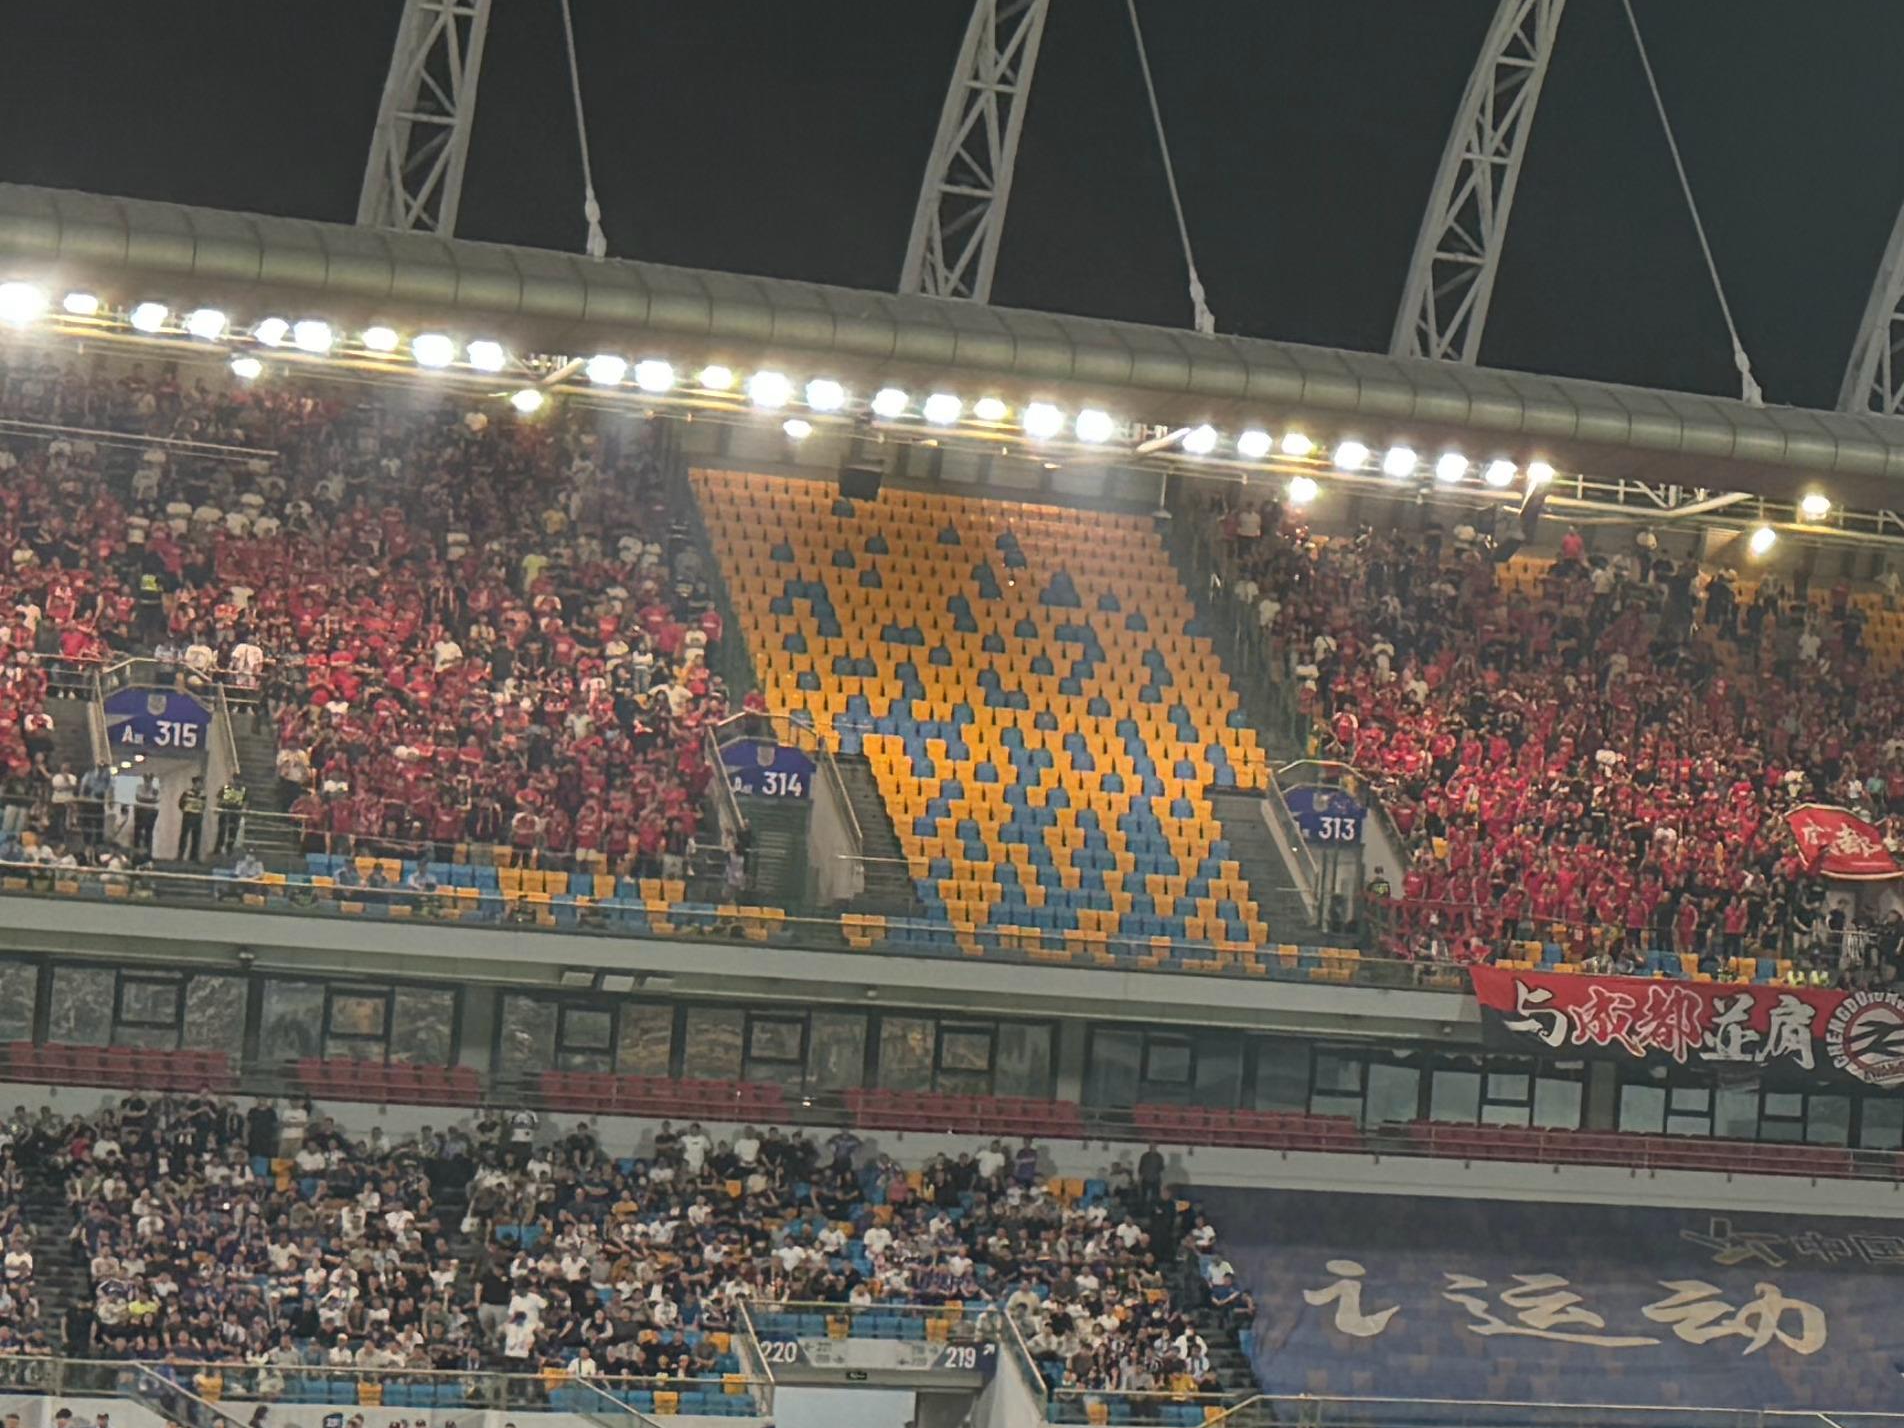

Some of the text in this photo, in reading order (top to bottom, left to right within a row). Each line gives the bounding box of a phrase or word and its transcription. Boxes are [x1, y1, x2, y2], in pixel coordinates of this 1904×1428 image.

[153, 719, 198, 748] 315
[761, 770, 803, 797] 314
[1318, 816, 1356, 841] 313
[944, 1346, 976, 1369] 219
